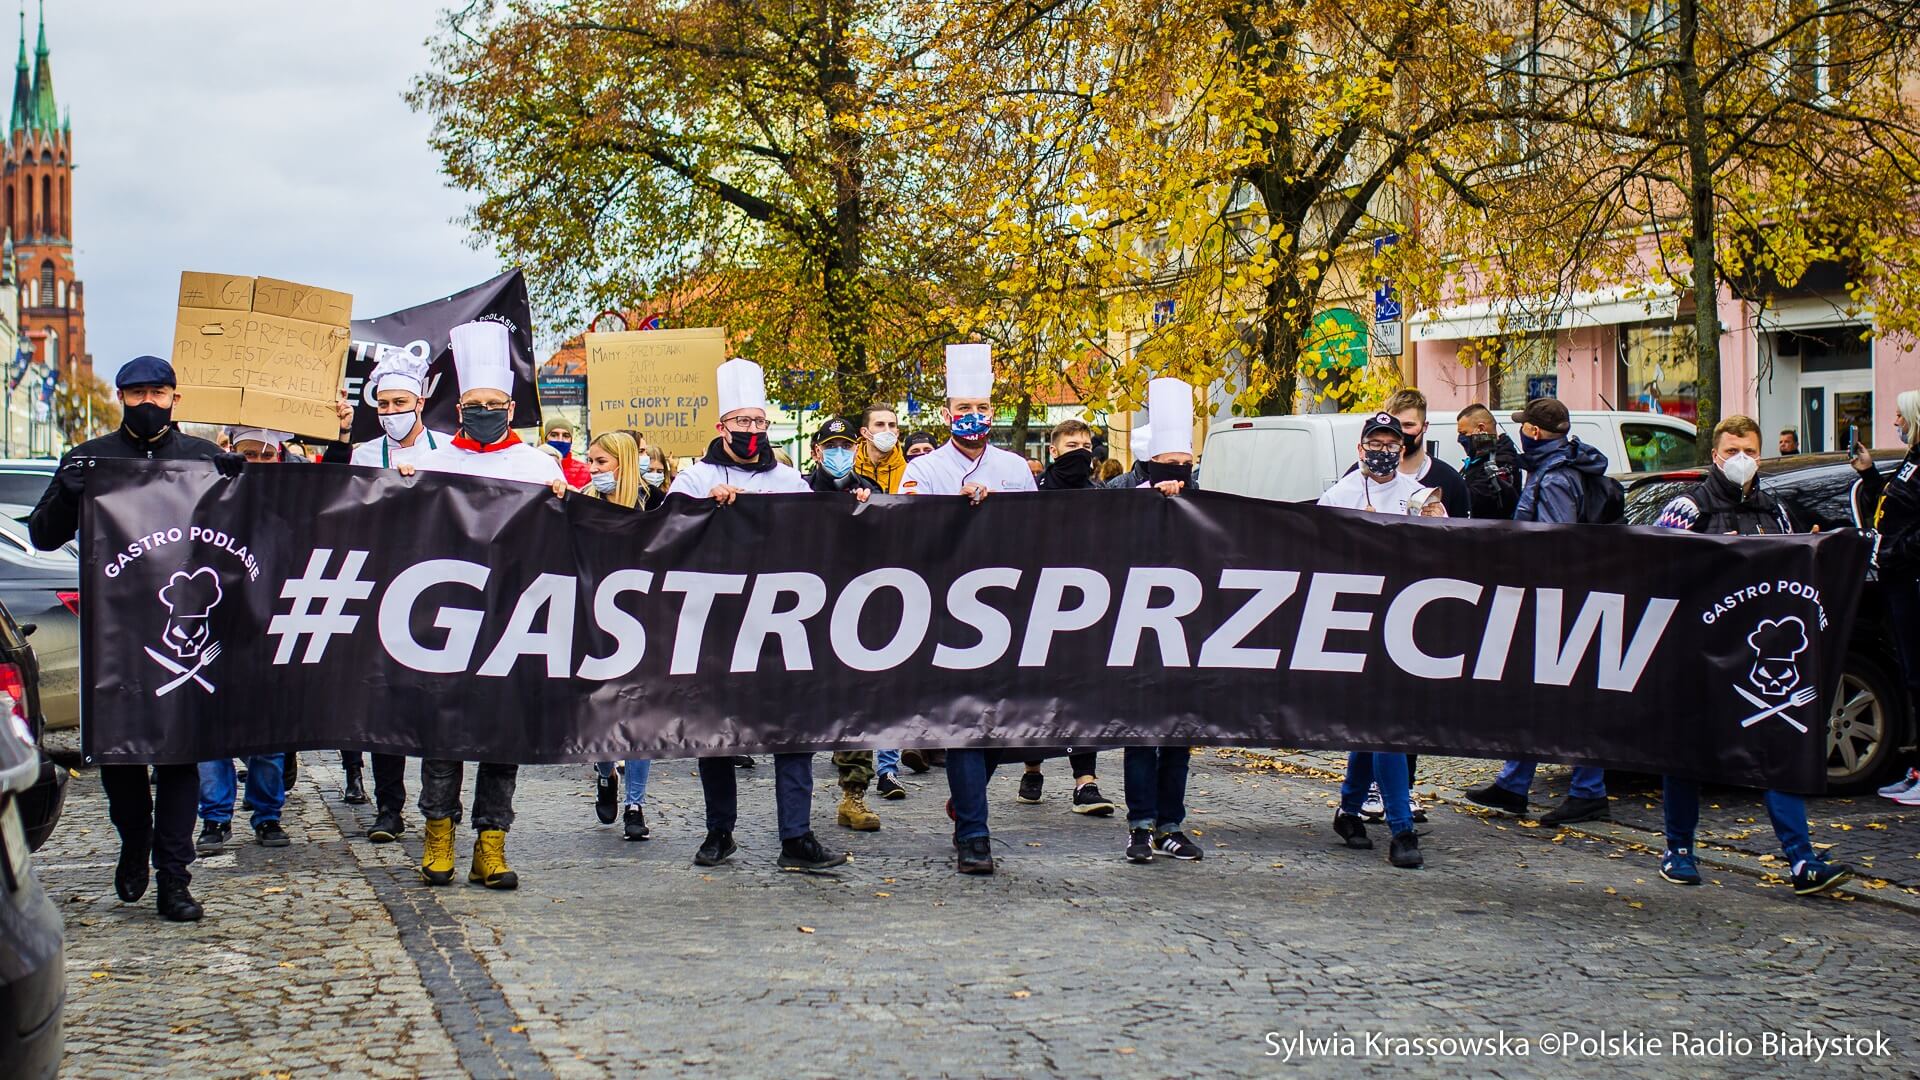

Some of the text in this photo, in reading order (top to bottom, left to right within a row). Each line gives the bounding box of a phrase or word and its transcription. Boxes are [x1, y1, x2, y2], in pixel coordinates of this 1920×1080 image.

[225, 319, 342, 354] SPRZECIW
[1381, 325, 1395, 337] TAXI
[177, 340, 333, 373] PIS JEST GORSZY
[183, 366, 220, 384] NIŻ
[231, 369, 282, 388] STEK
[287, 376, 324, 395] WELL
[275, 397, 325, 418] DONE
[605, 400, 625, 409] TEN
[630, 397, 670, 408] CHORY
[677, 396, 709, 409] RZĄD
[628, 414, 638, 427] W
[105, 526, 260, 582] GASTRO PODLASIE
[1702, 582, 1771, 624] GASTRO
[267, 547, 1678, 693] #GASTROSPRZECIW
